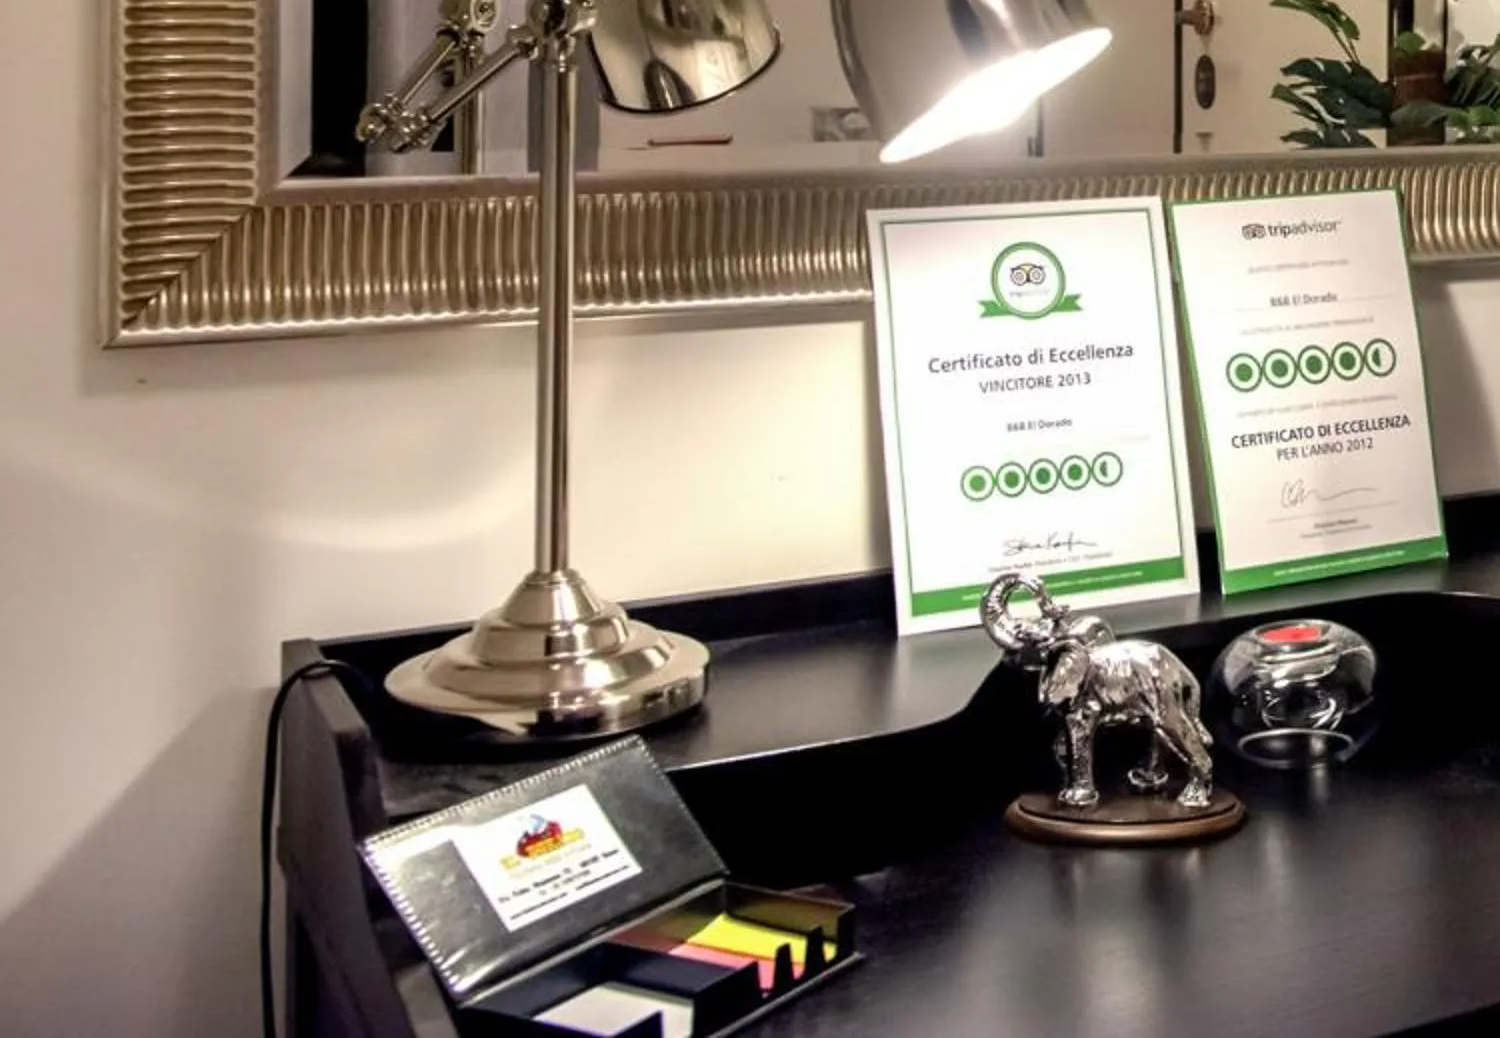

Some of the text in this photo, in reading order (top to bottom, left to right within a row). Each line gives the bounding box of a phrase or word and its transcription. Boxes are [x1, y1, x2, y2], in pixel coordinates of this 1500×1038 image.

[928, 344, 1134, 374] Certificato di Eccellenza
[979, 371, 1092, 394] VINCITORE 2013
[1231, 414, 1411, 449] CERTIFICATO DI ECCELLENZA
[1276, 437, 1375, 462] PER L'ANNO 2012
